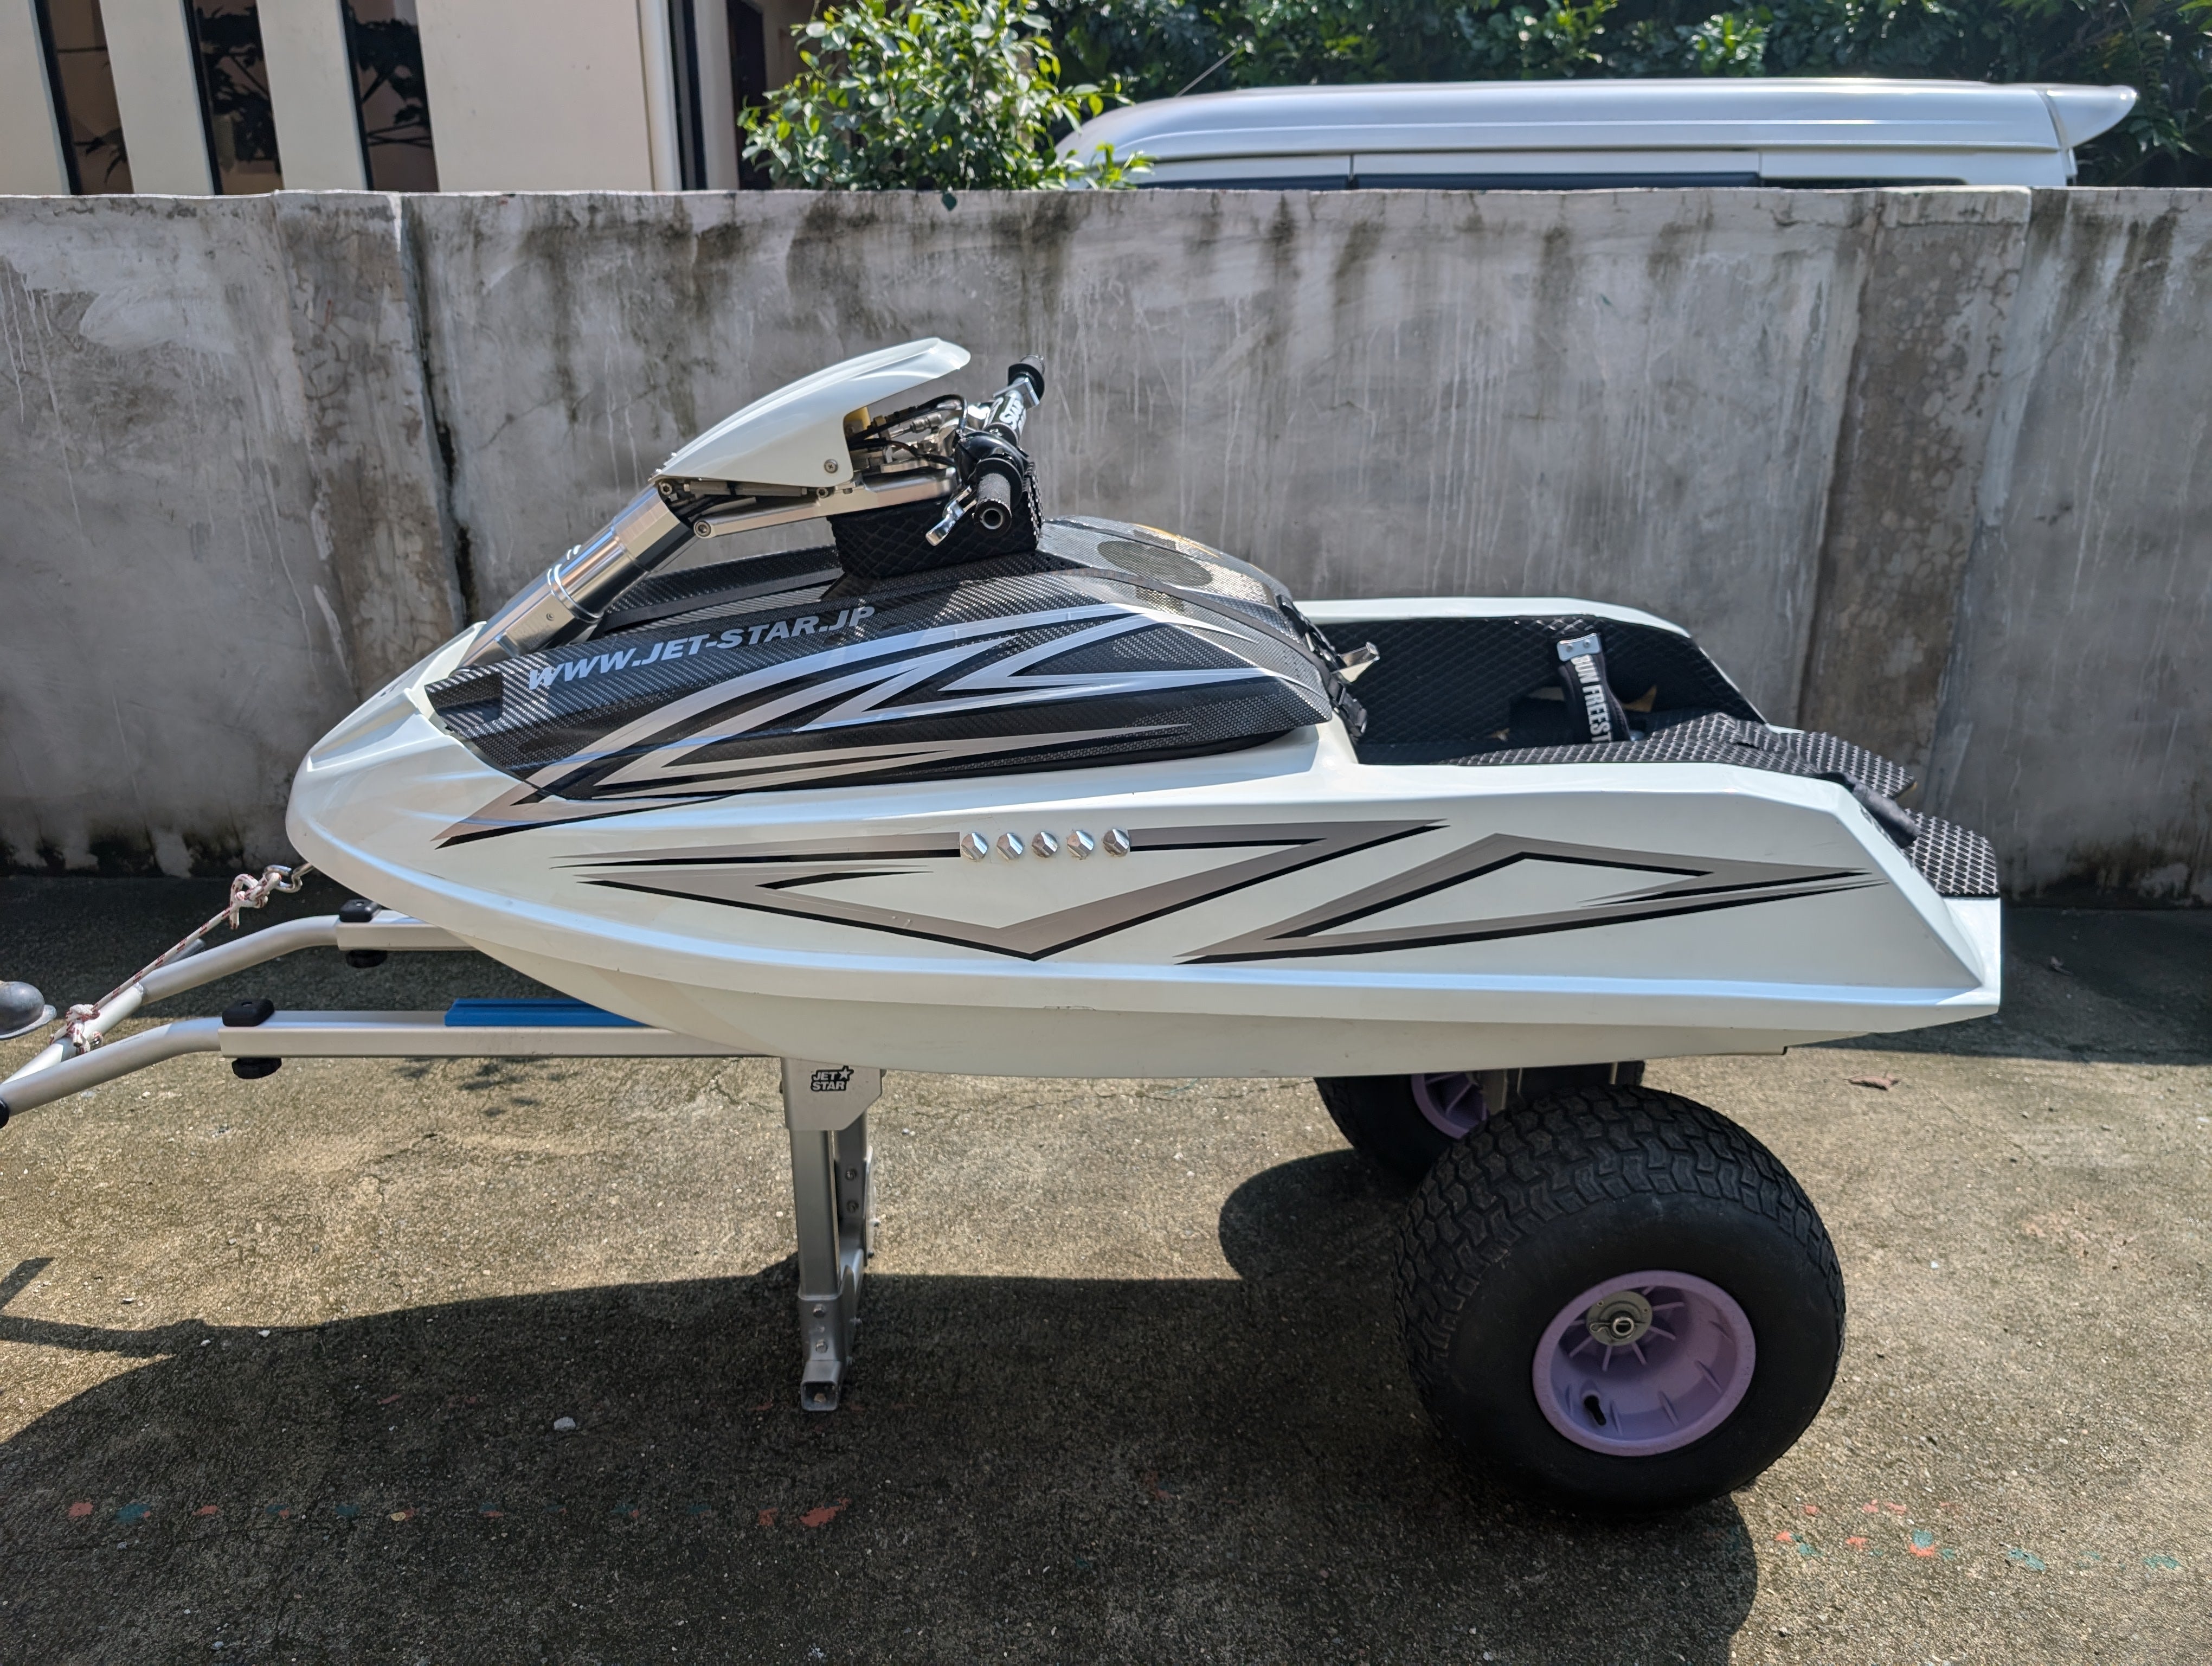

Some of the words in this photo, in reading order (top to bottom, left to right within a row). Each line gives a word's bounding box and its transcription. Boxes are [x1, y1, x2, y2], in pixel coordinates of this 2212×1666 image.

[528, 606, 875, 690] WWW.JET-STAR.JP
[813, 1072, 838, 1080] JET
[812, 1081, 845, 1090] STAR
